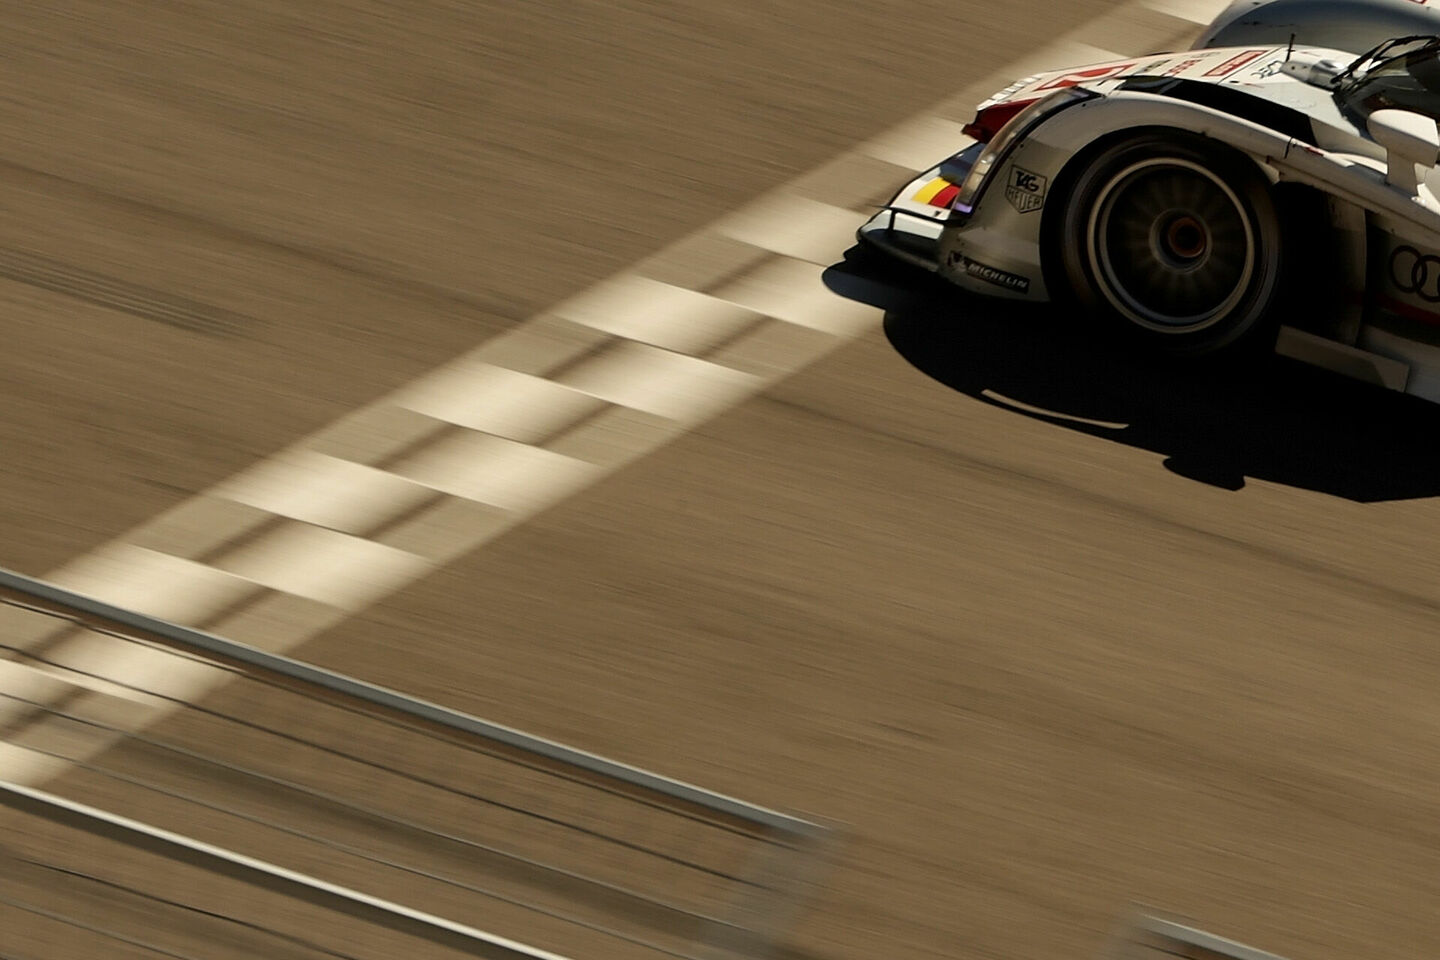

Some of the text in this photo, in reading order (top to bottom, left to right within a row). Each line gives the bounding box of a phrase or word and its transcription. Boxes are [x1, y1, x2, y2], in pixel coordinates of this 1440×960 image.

[1016, 171, 1039, 192] TAG
[1007, 188, 1042, 210] HEUER
[968, 262, 1029, 289] MICHELIN
